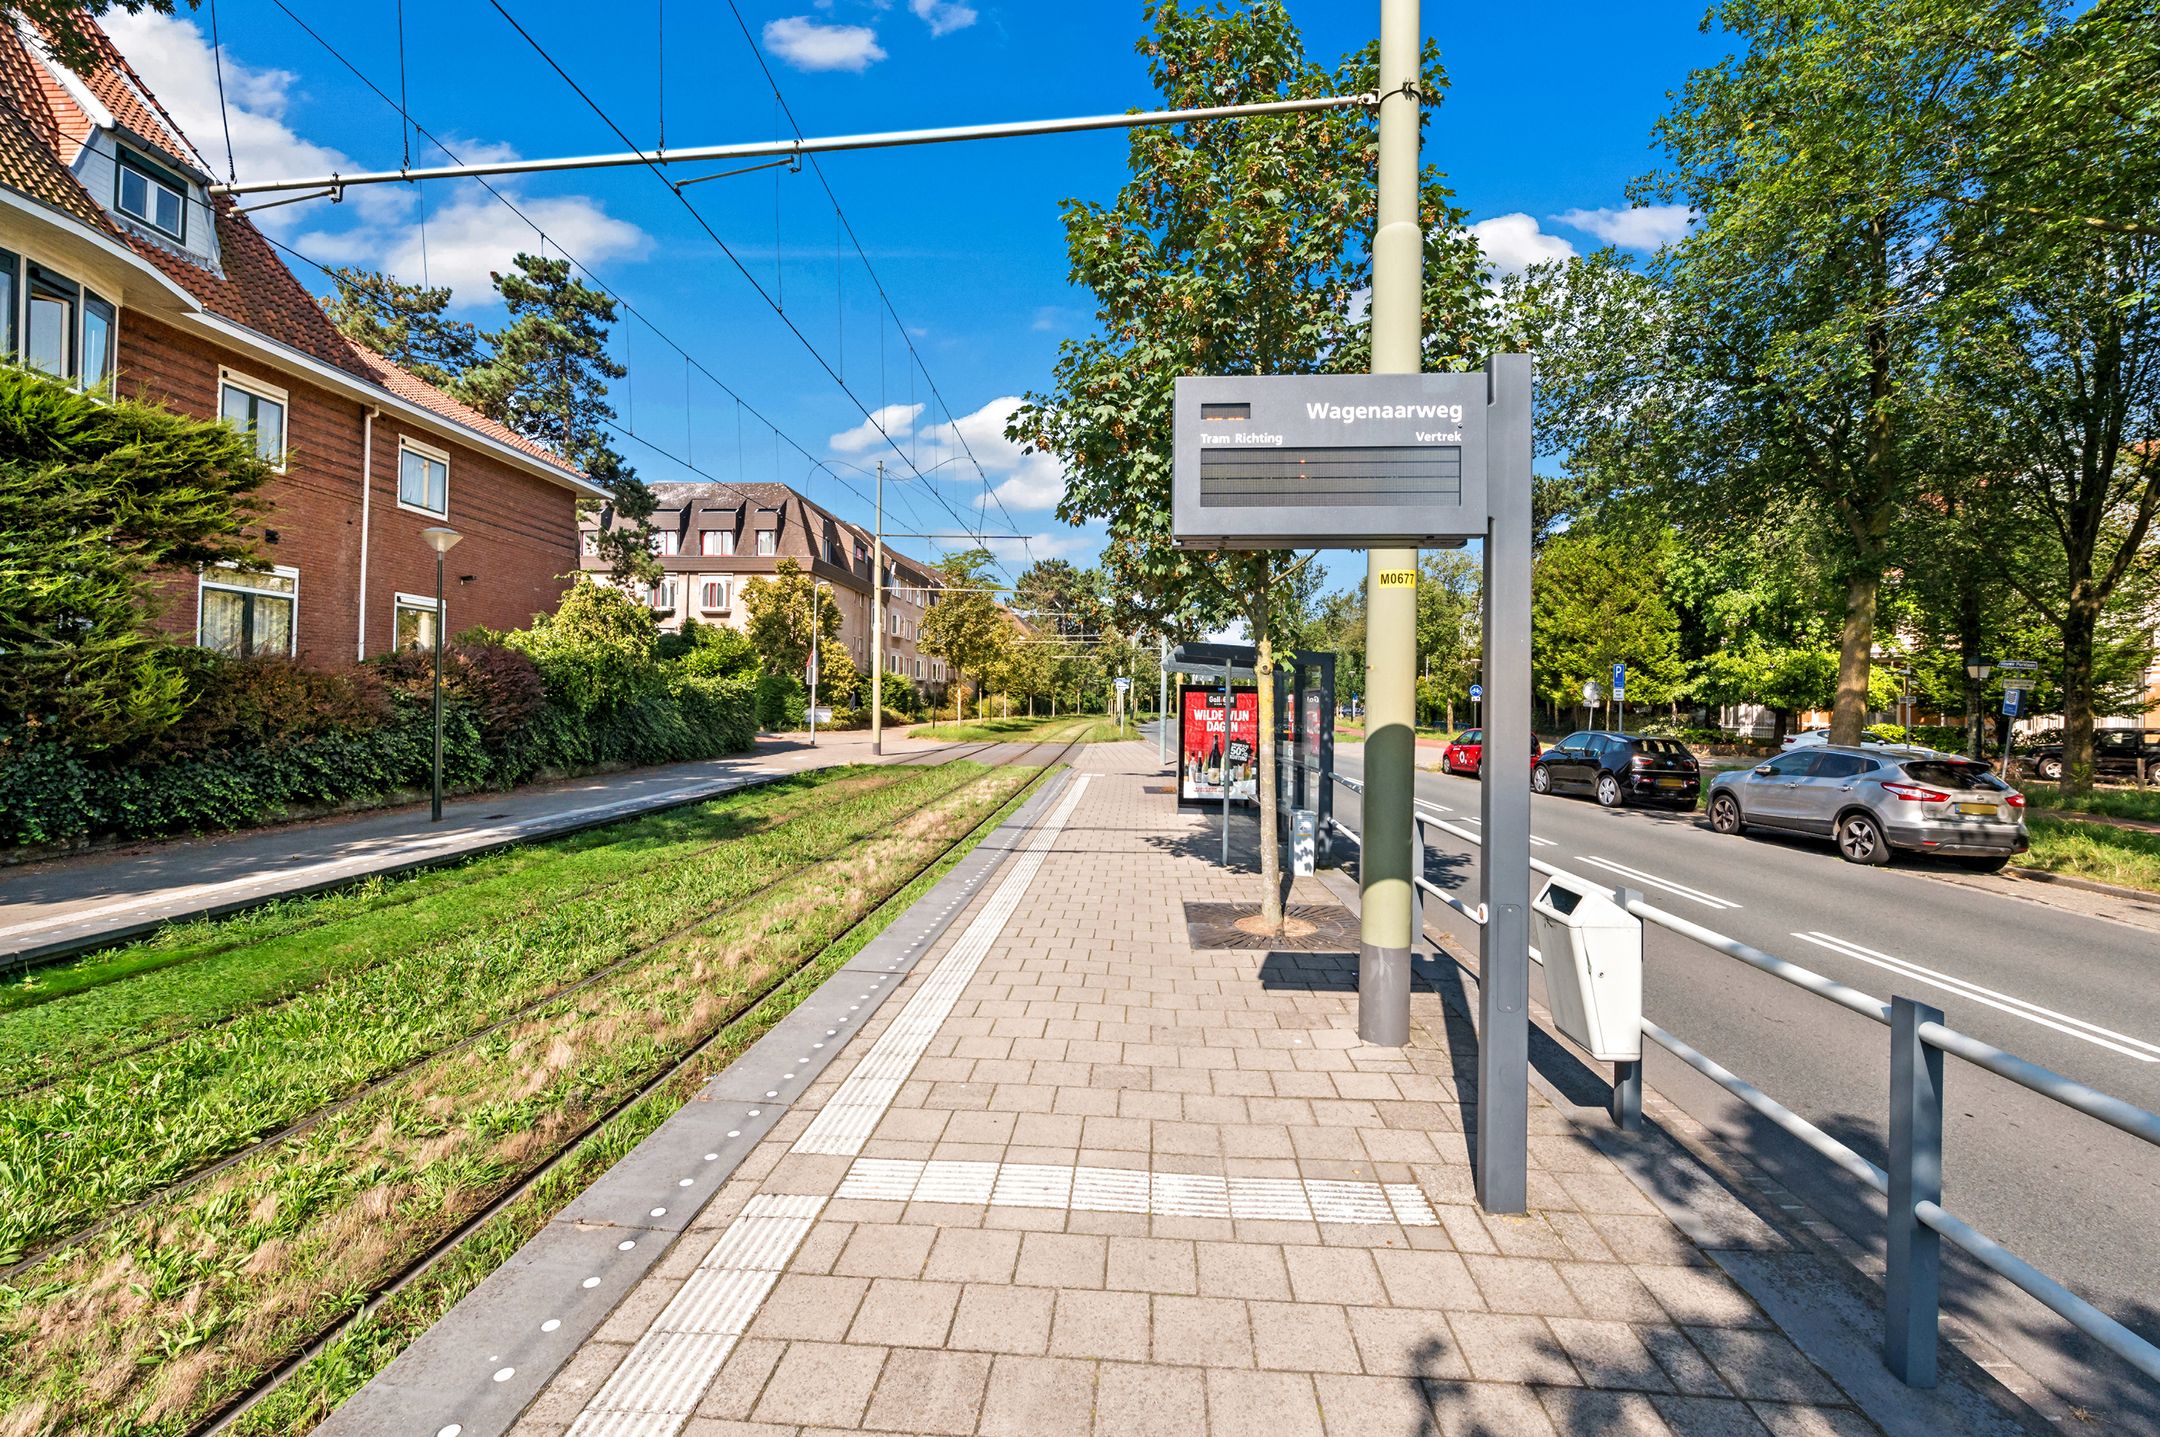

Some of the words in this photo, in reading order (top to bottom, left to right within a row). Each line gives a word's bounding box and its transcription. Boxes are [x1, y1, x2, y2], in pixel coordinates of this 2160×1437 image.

[1306, 402, 1463, 423] Wagenaarweg
[1200, 433, 1230, 444] Tram
[1235, 432, 1283, 446] Richting
[1416, 431, 1462, 442] Vertrek
[1380, 573, 1415, 585] M0677
[1615, 665, 1622, 679] P
[1194, 709, 1224, 721] WILDE
[1206, 721, 1239, 733] DAGN
[1230, 745, 1250, 758] 50%
